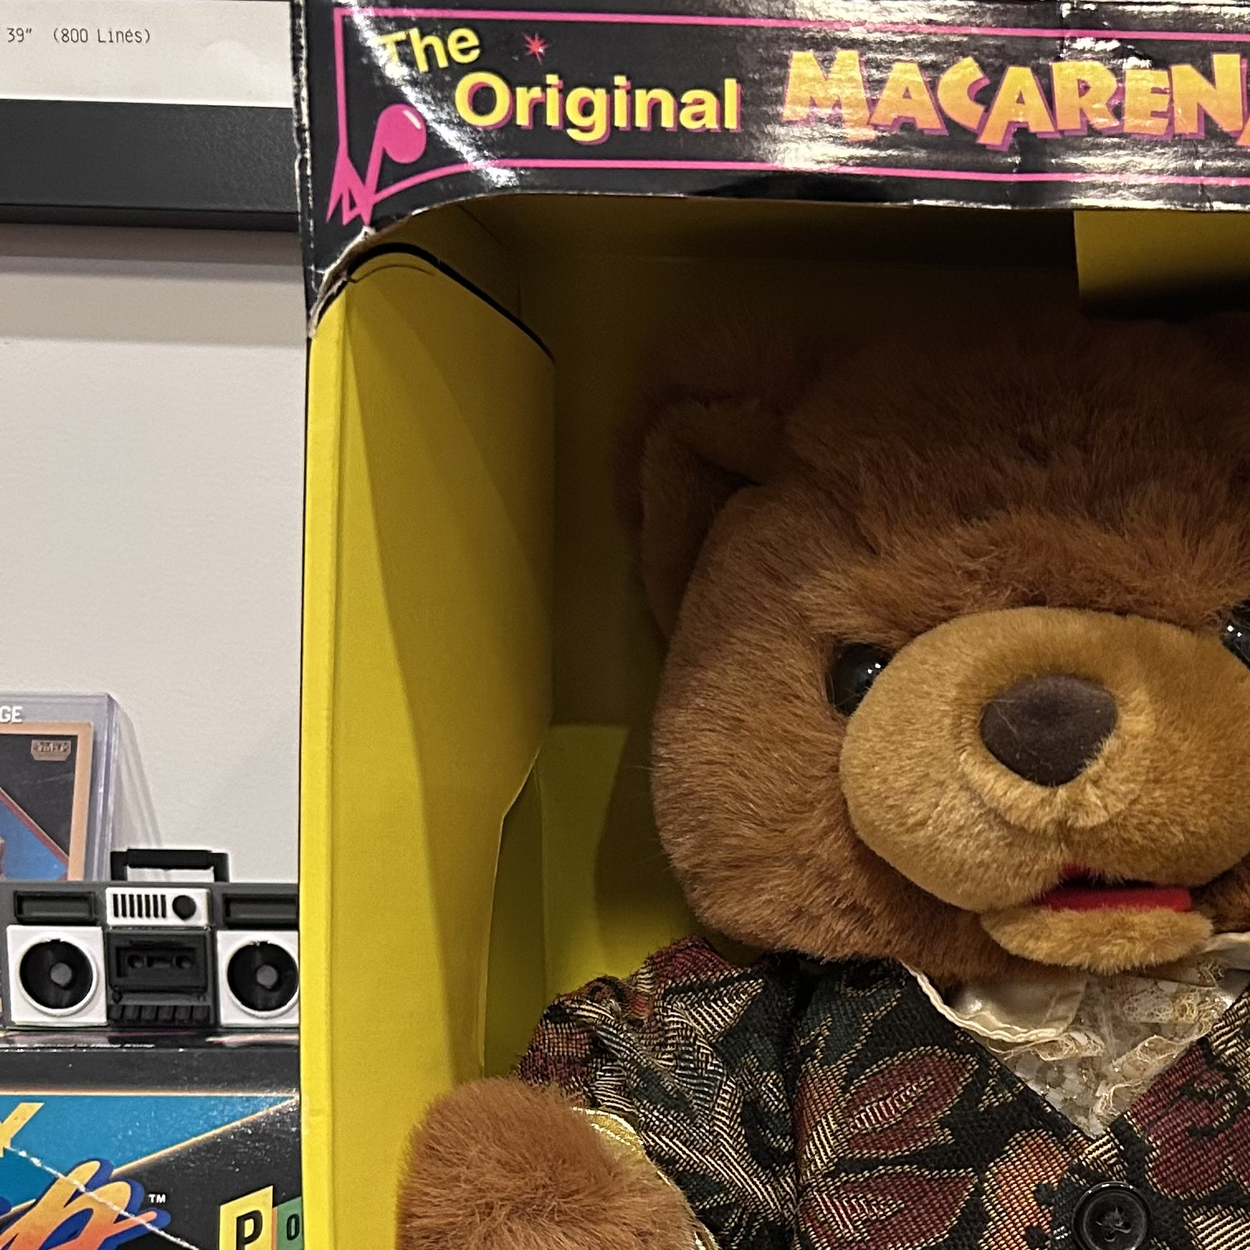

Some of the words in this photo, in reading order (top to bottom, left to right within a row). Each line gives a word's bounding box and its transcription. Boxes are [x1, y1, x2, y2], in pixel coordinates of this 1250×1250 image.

[53, 27, 89, 44] (800
[97, 28, 151, 44] Lines)
[378, 26, 481, 74] The
[455, 70, 741, 145] Original
[149, 1194, 166, 1203] TM
